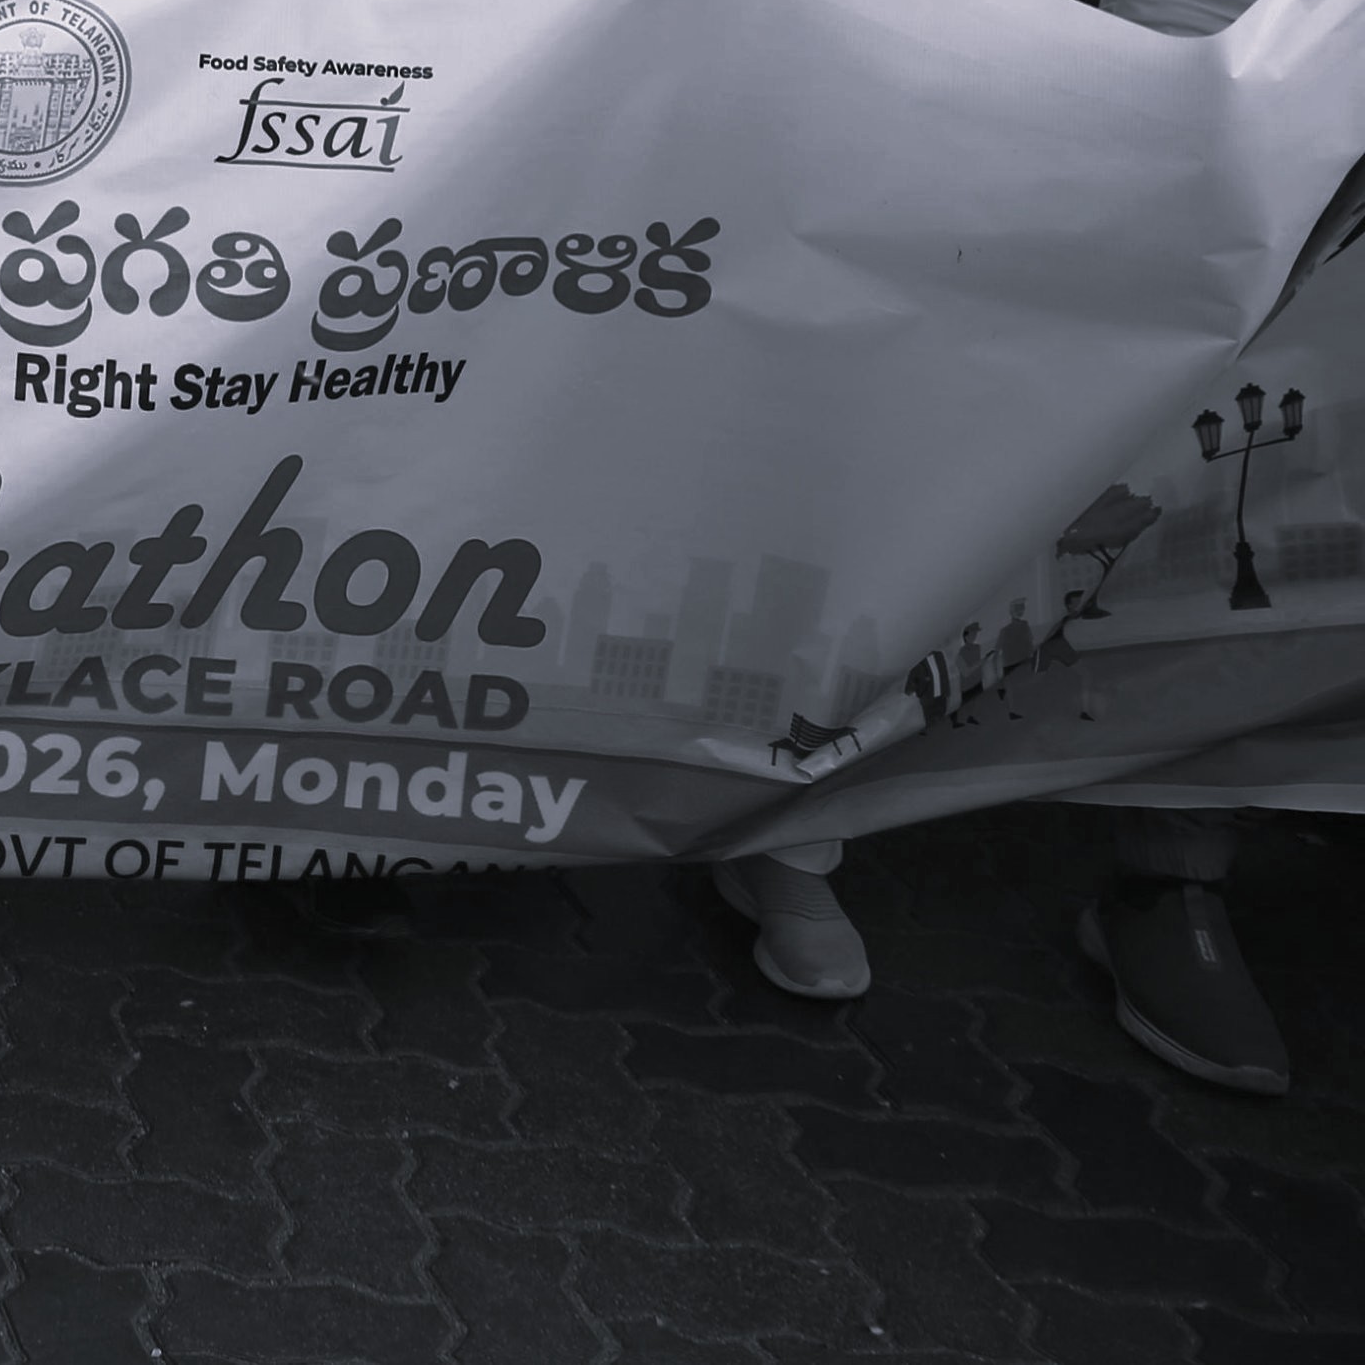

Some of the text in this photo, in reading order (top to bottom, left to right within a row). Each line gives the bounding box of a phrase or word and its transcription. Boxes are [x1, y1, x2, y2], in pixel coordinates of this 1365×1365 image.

[29, 0, 50, 16] OF
[61, 8, 117, 85] TELANGANA
[199, 53, 434, 82] Food Safety Awareness
[213, 79, 411, 173] fssai
[312, 213, 723, 353] ప్రణాళిక
[13, 352, 158, 418] Right
[171, 357, 281, 414] Stay
[288, 349, 466, 406] Healthy
[270, 661, 533, 733] ROAD
[200, 740, 588, 844] Monday
[104, 838, 186, 881] OF
